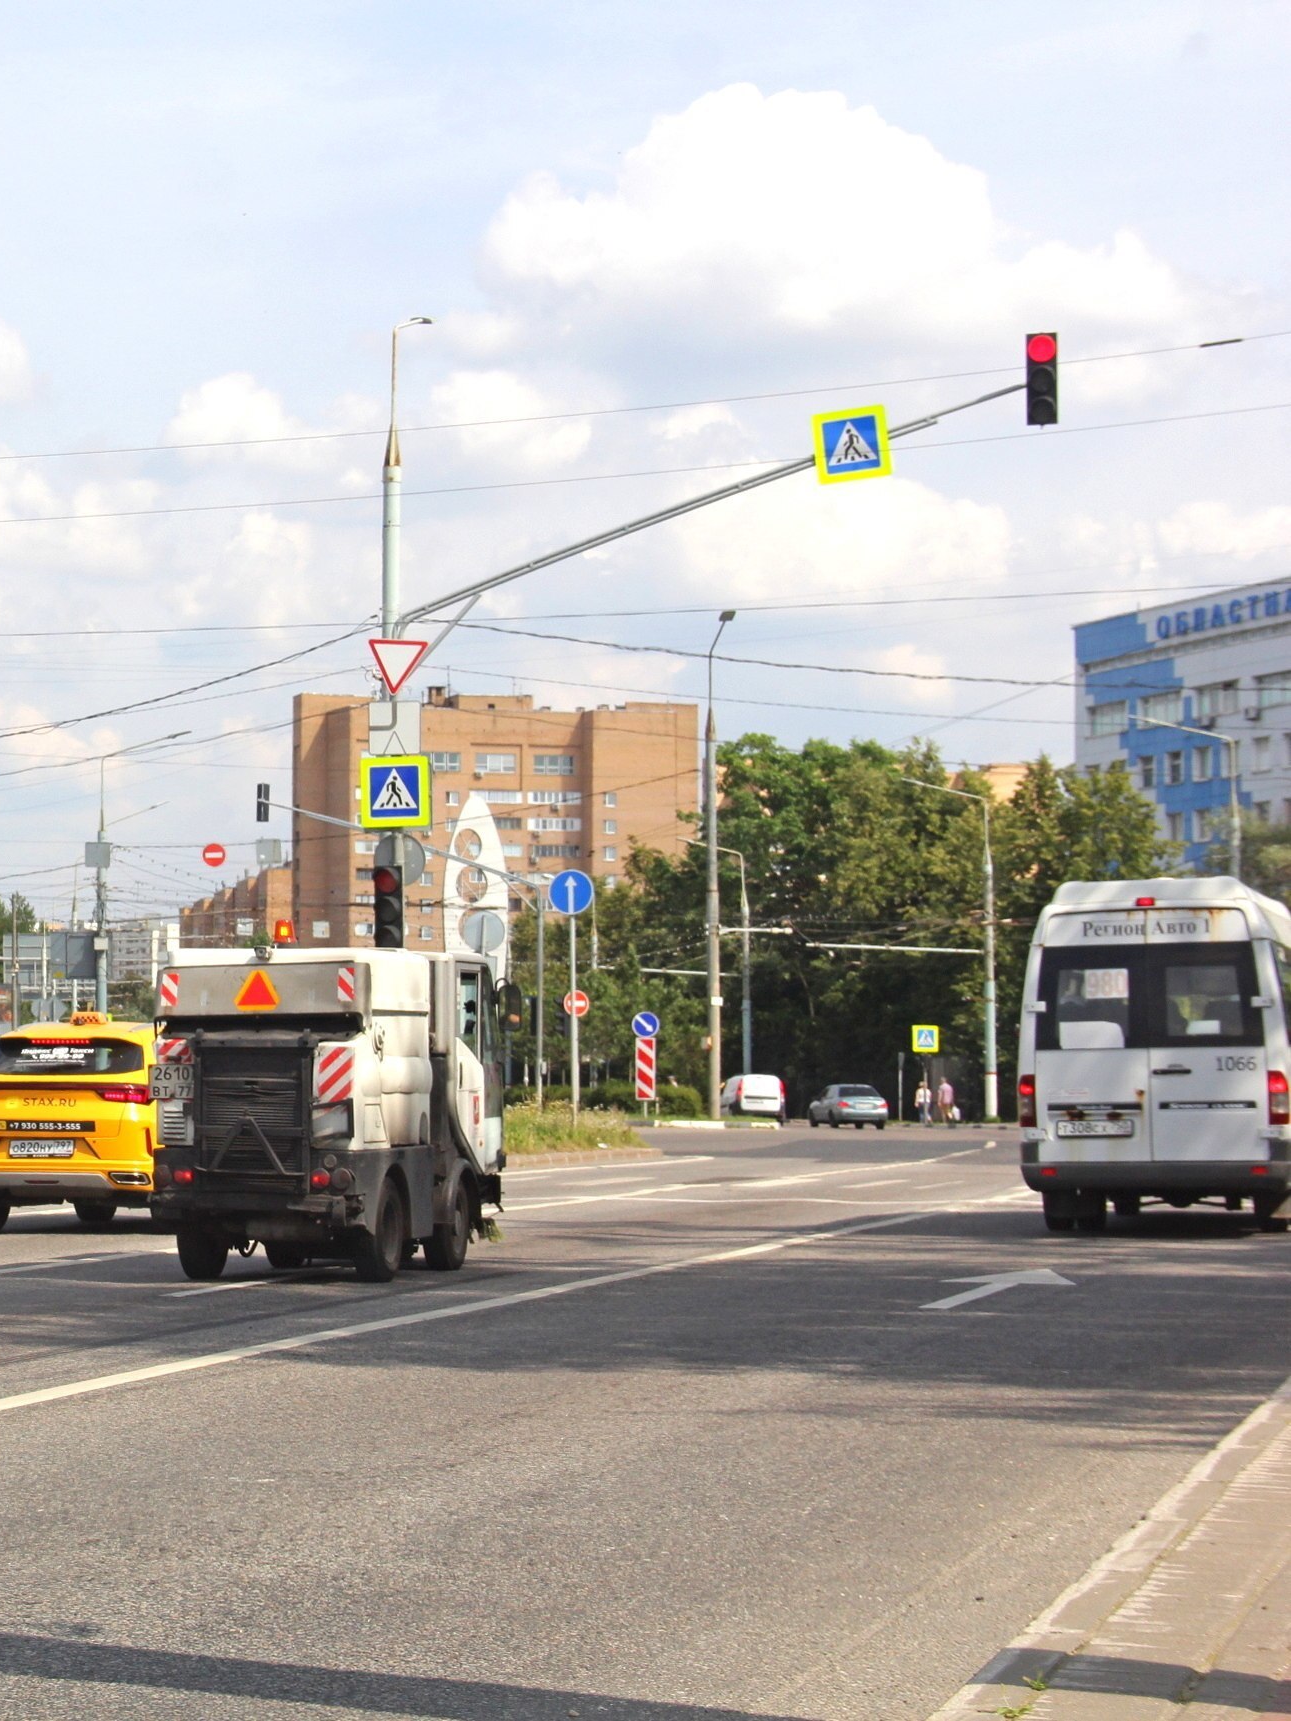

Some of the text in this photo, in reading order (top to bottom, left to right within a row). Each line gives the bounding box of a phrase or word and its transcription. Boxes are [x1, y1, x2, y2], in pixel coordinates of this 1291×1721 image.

[1082, 921, 1146, 937] Регион
[1152, 920, 1197, 935] Авто
[1215, 1056, 1258, 1071] 1066
[154, 1066, 190, 1081] 2610
[23, 1097, 77, 1108] STAX.RU
[21, 1122, 37, 1130] 930
[39, 1122, 81, 1130] 555-3-555
